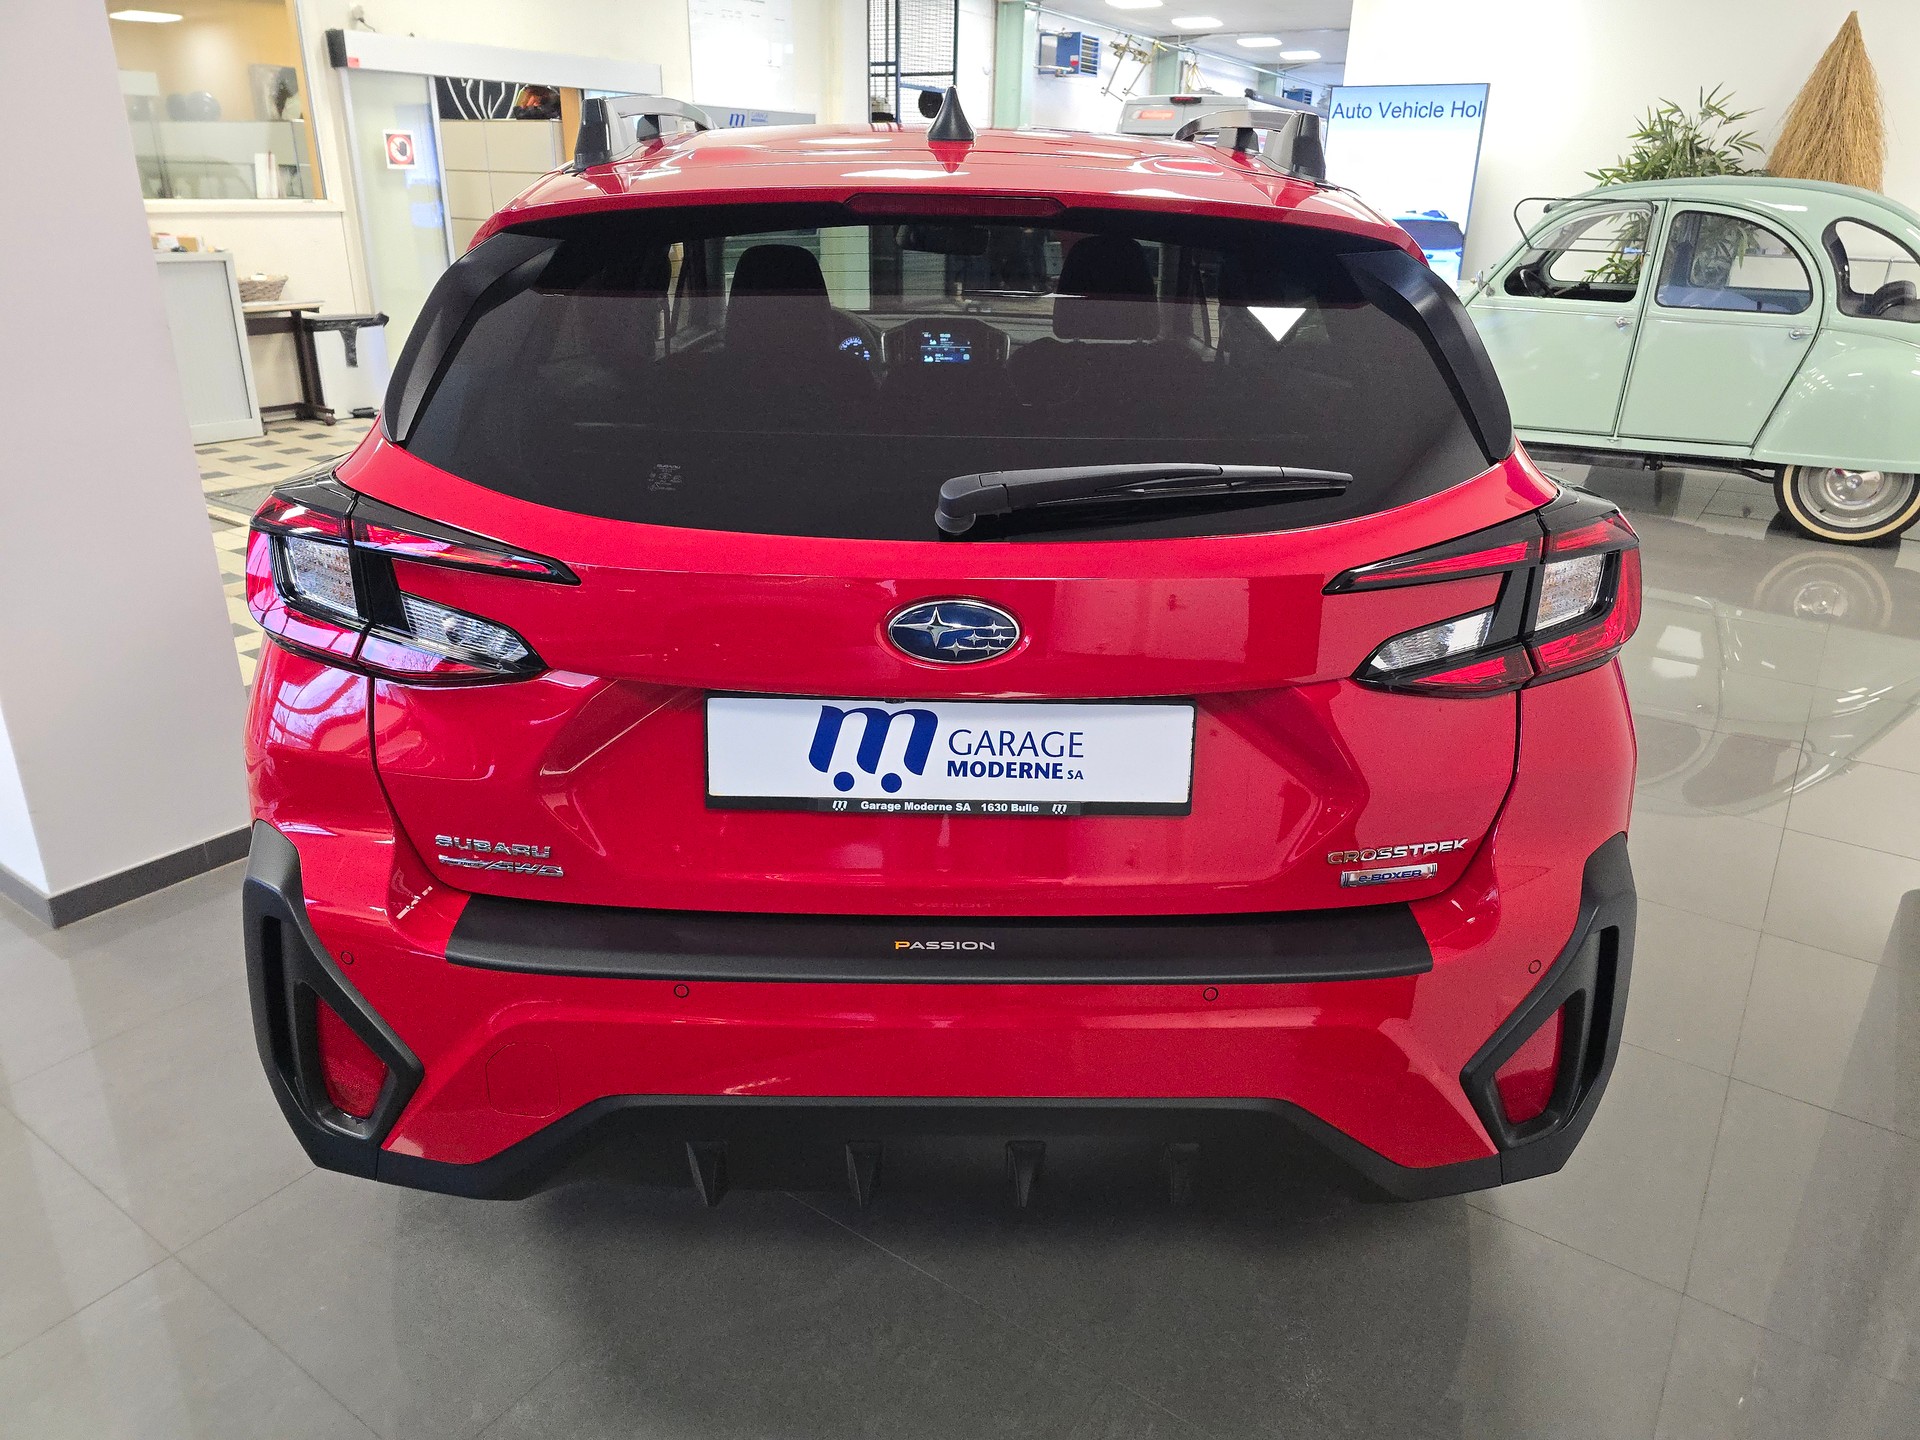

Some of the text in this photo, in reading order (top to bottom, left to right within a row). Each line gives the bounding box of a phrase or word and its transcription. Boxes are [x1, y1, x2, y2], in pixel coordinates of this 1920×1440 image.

[1332, 100, 1486, 119] Auto Vehicle Hol
[948, 729, 1084, 758] GARAGE
[946, 760, 1084, 780] MODERNE SA
[860, 800, 901, 812] Garage
[904, 801, 952, 811] Moderne
[955, 802, 971, 812] SA
[981, 802, 1008, 812] 1630
[1011, 802, 1039, 813] Bulle
[435, 834, 550, 858] SUBARU
[1327, 838, 1468, 864] CROSSTREK
[486, 860, 563, 877] AWD
[1358, 869, 1422, 883] e-BOXER
[894, 941, 996, 950] PASSION
